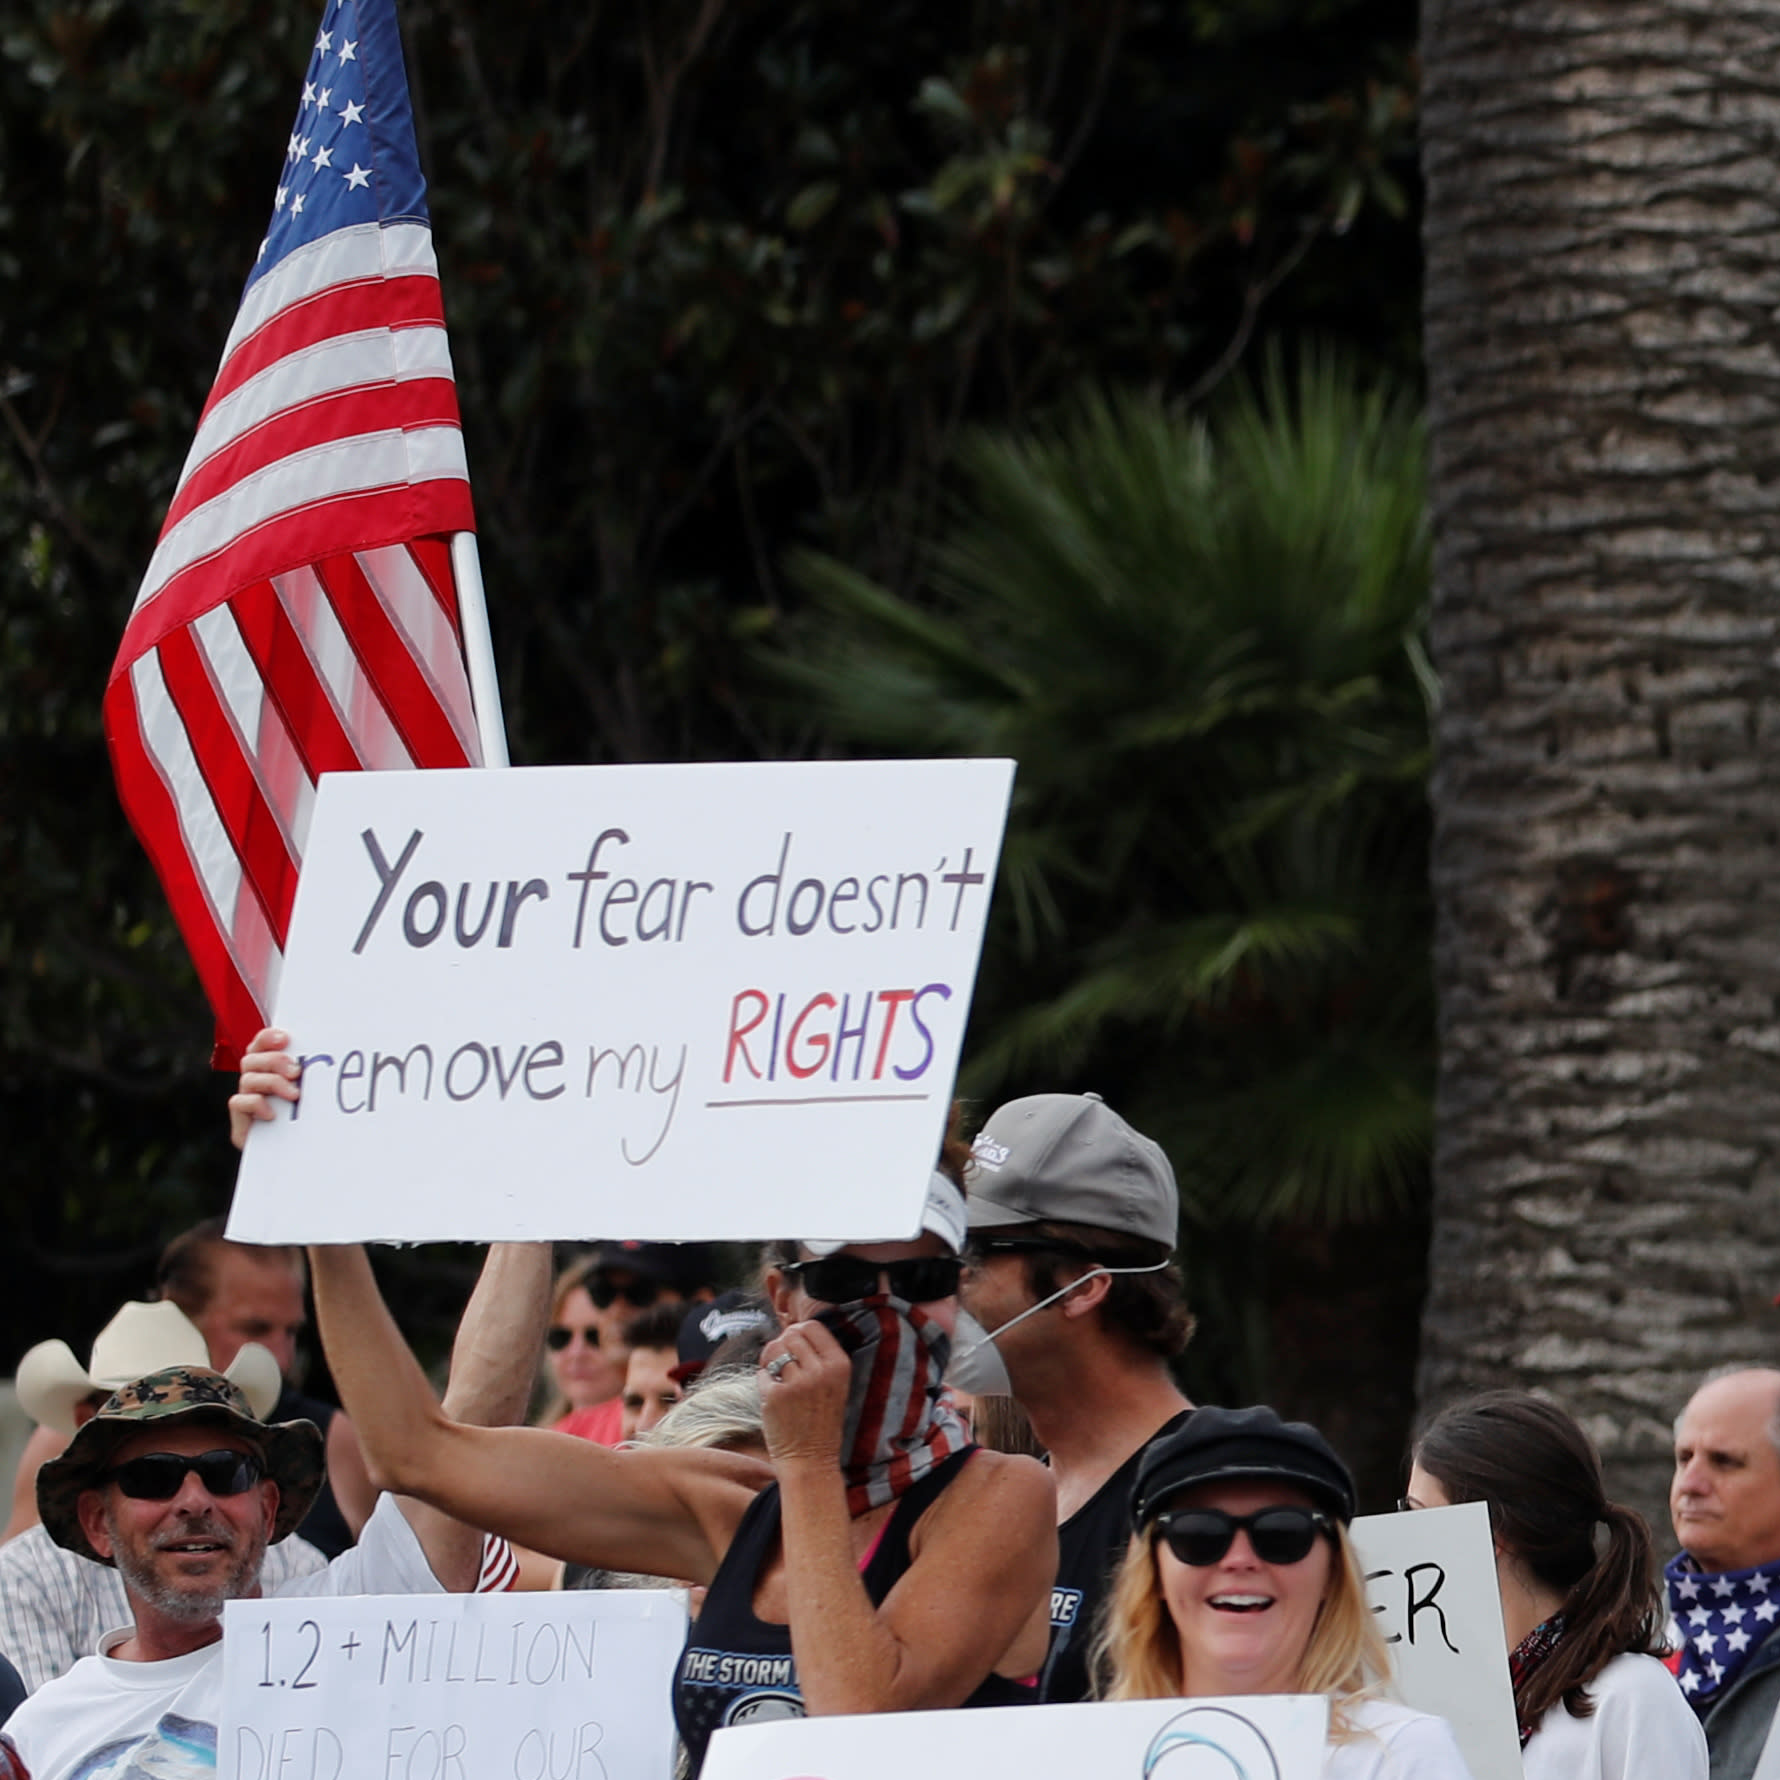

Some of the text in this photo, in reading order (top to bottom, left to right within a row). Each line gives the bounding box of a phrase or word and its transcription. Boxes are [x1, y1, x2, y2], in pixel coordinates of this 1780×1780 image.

[352, 826, 985, 956] Your fear doesn't
[288, 982, 952, 1166] remove my RIGHTS
[379, 1618, 598, 1686] MILLION
[683, 1651, 718, 1682] THE
[717, 1656, 790, 1687] STORM
